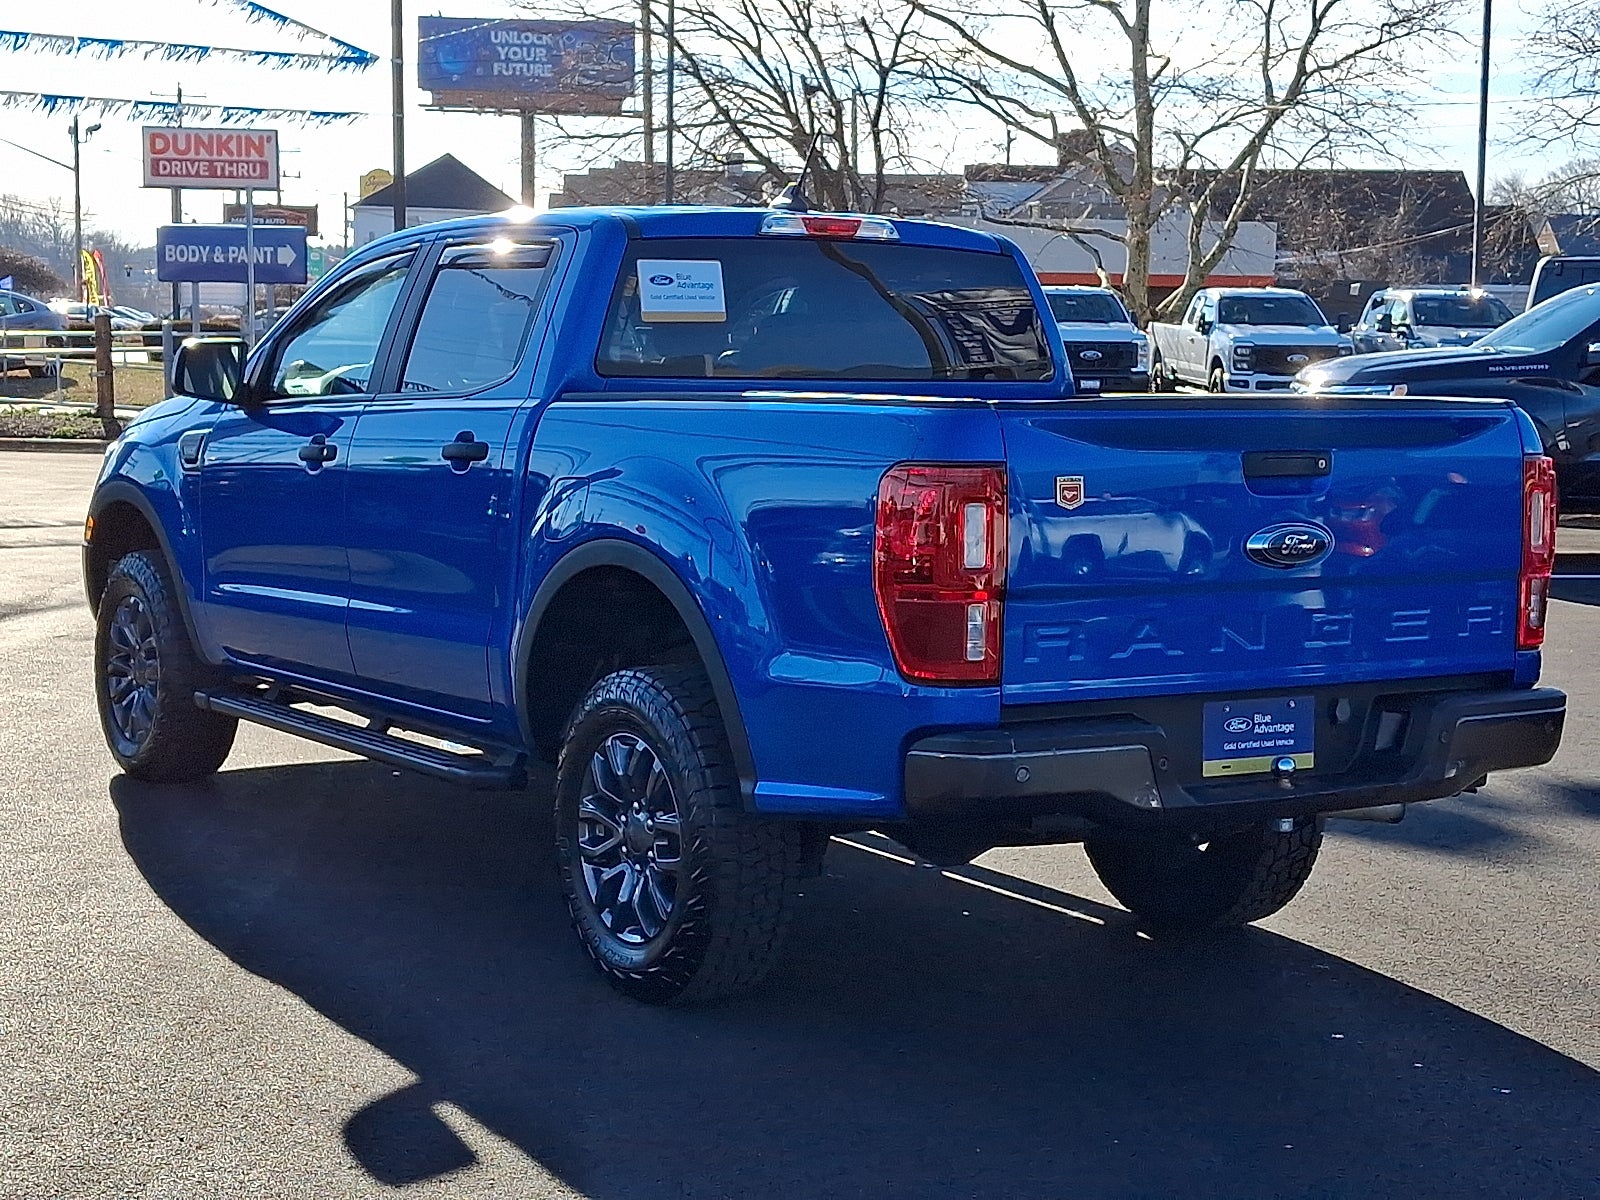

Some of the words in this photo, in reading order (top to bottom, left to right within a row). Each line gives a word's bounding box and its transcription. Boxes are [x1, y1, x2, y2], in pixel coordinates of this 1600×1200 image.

[490, 30, 552, 45] UNLOCK
[498, 46, 547, 62] YOUR
[492, 62, 552, 77] FUTURE
[159, 160, 209, 176] DRIVE
[213, 161, 260, 177] THRU
[165, 244, 210, 263] BODY
[213, 245, 225, 263] &
[228, 246, 274, 265] PANT
[676, 272, 692, 281] Blue
[676, 281, 714, 291] Advantage
[1281, 533, 1317, 555] Ford
[1023, 606, 1504, 663] RANGER
[1254, 713, 1272, 724] Blue
[1253, 723, 1295, 734] Advantage
[1223, 742, 1237, 751] Gold
[1237, 740, 1260, 749] Certified
[1260, 739, 1275, 748] Used
[1275, 738, 1295, 747] Vehicle
